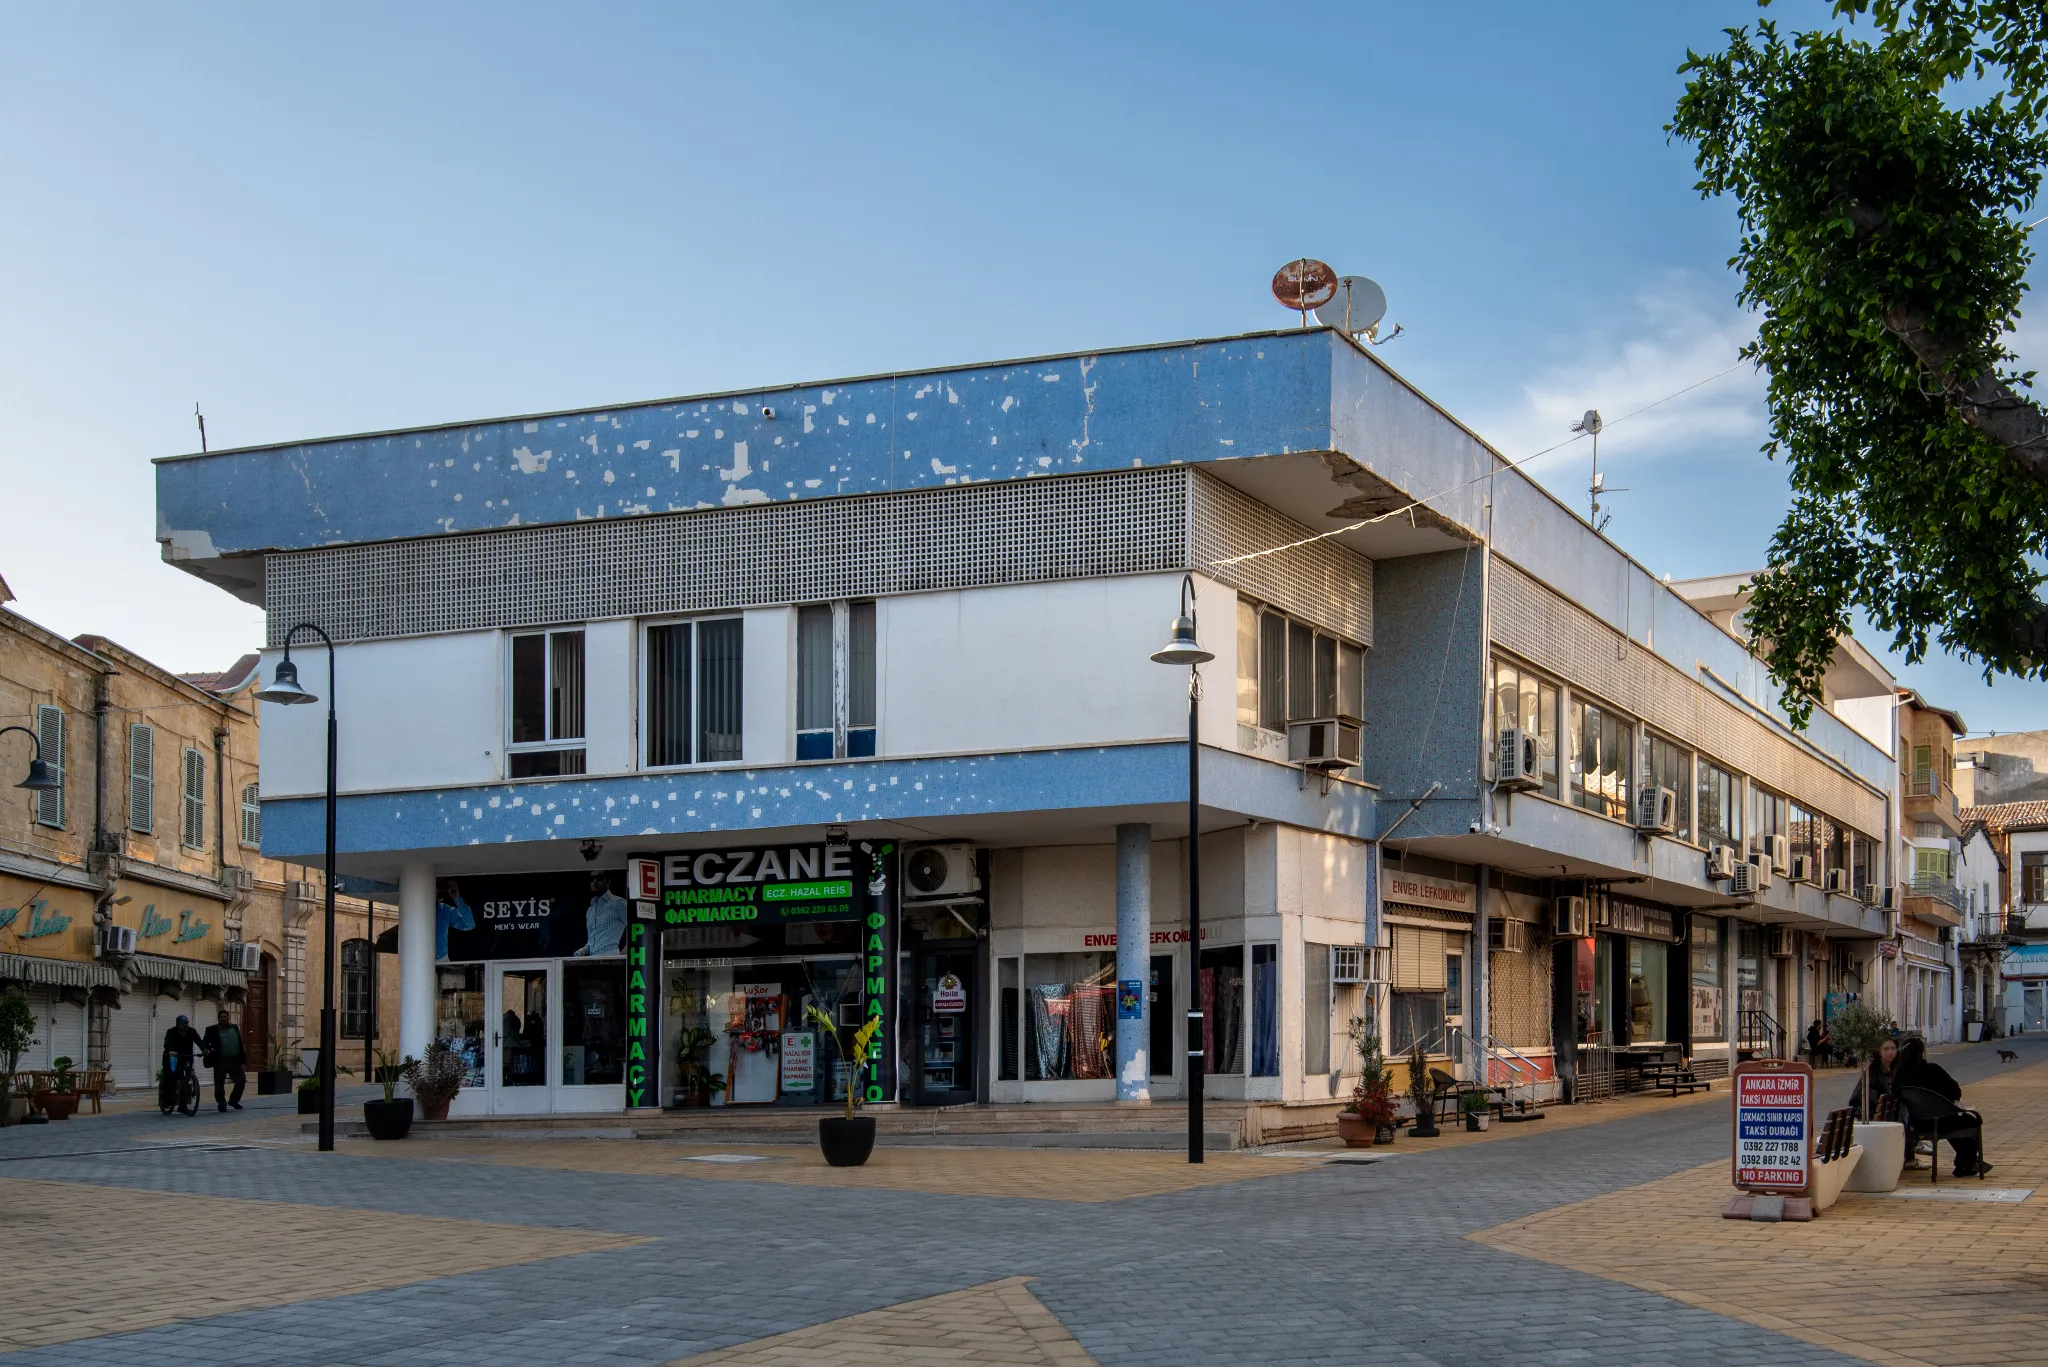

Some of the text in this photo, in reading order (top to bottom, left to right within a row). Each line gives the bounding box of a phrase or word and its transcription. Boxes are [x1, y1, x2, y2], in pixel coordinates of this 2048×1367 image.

[664, 846, 853, 887] ECZANE
[642, 864, 656, 895] E
[664, 886, 757, 905] PHARMACY
[766, 884, 846, 899] ECZ. HAZAL REİS
[1392, 880, 1466, 904] ENVER LEFKONUKLU
[483, 897, 550, 919] SEYİS
[790, 906, 809, 915] 0392
[827, 905, 837, 913] 65
[838, 904, 849, 912] 05
[494, 922, 540, 931] MEN'S WEAR
[629, 923, 646, 1108] PHARMACY
[787, 1038, 794, 1046] E
[1745, 1079, 1776, 1090] ANKARA
[1741, 1112, 1803, 1122] LOKMACI SINIR KAPISI
[1769, 1125, 1799, 1136] DURAĞI
[1743, 1141, 1799, 1152] 0392 227 1788
[1741, 1155, 1801, 1165] 0392 887 82 42
[1742, 1170, 1800, 1182] NO PARKING
